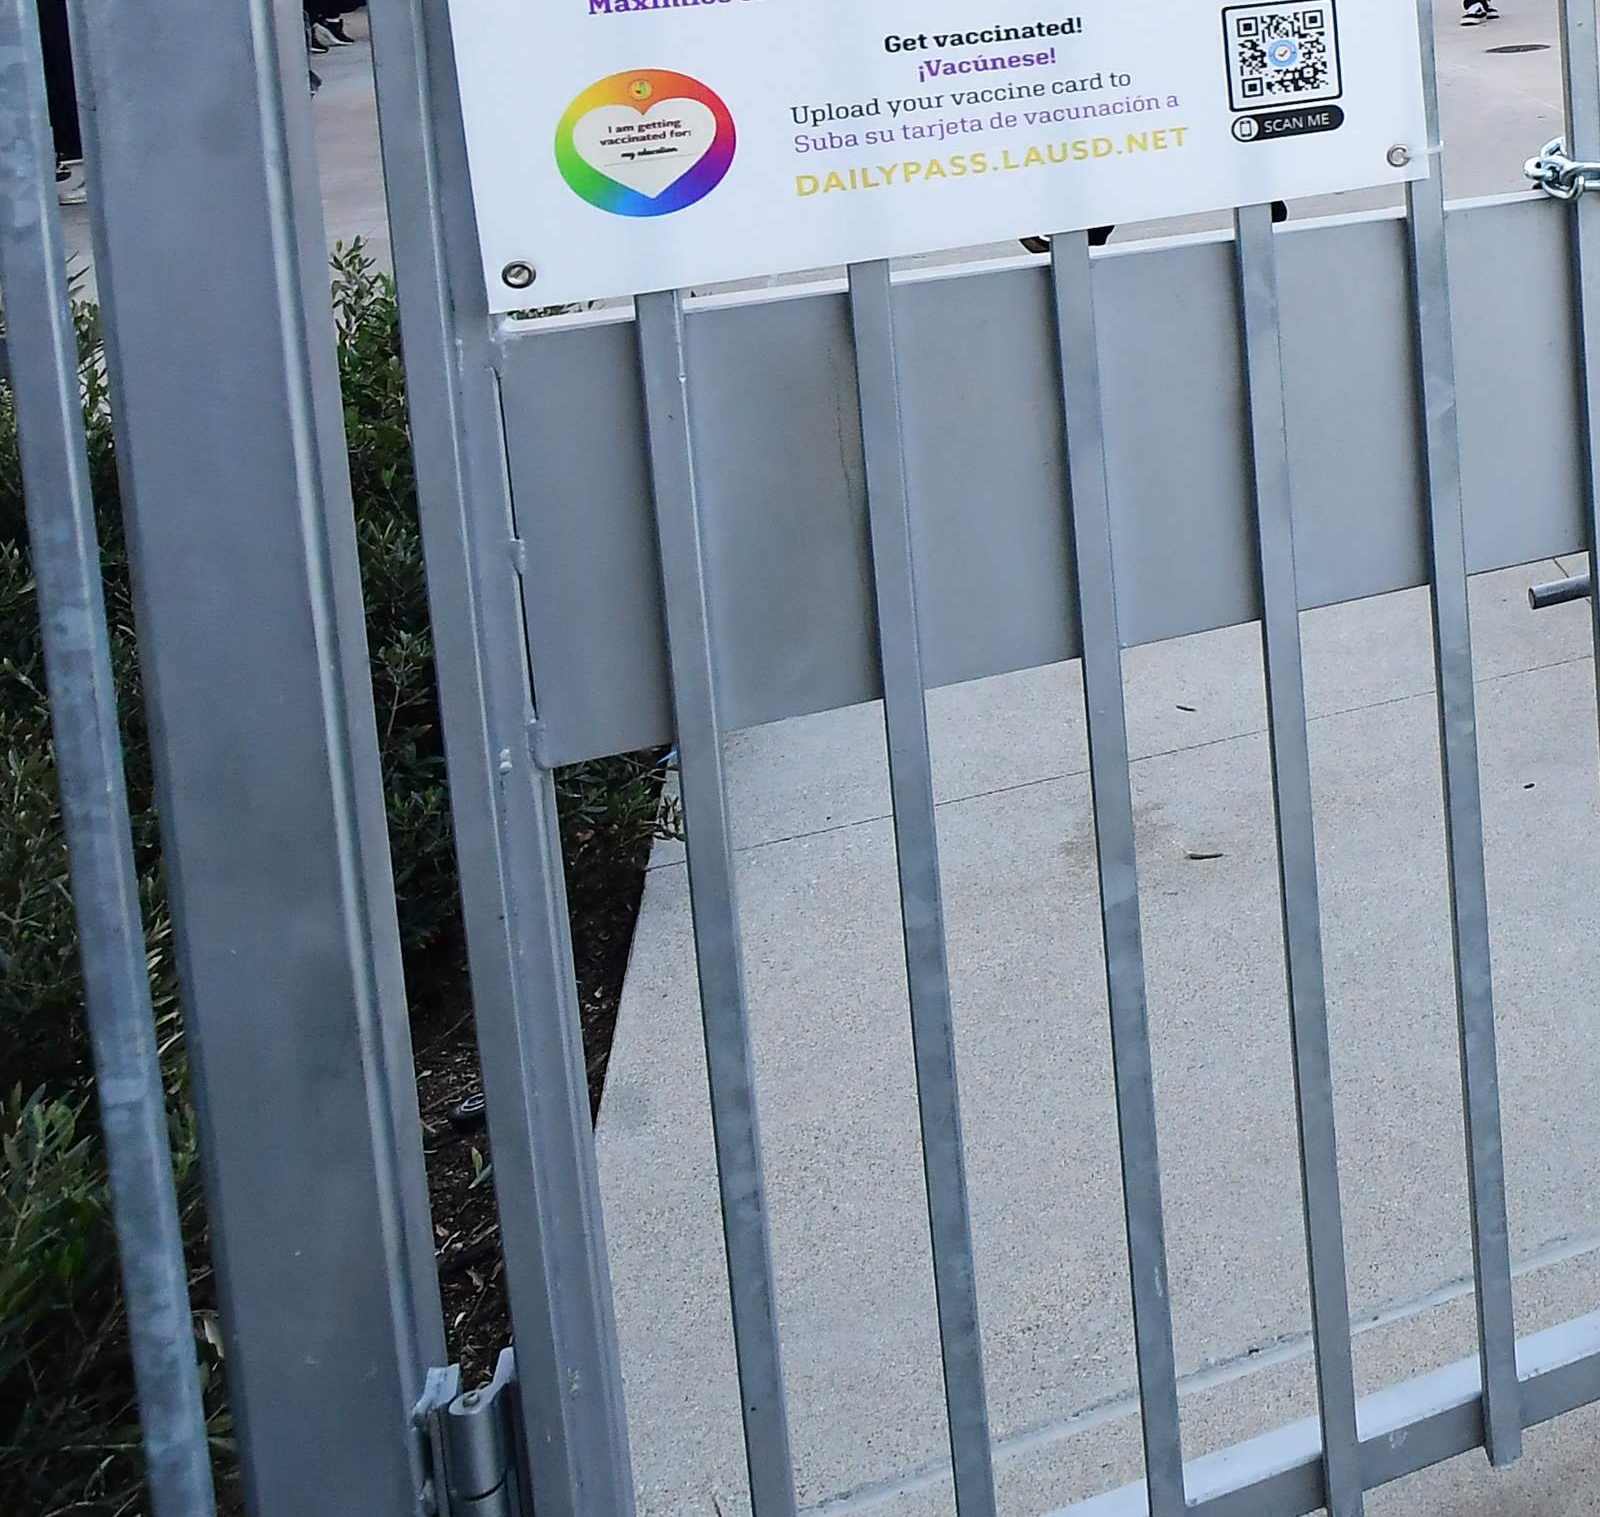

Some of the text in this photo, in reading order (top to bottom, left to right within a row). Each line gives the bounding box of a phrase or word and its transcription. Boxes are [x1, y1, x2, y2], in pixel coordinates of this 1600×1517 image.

[884, 16, 1082, 52] Get vaccinated!
[918, 46, 1055, 82] ¡Vacúnese!
[789, 72, 1130, 127] Upload your vaccine card to
[600, 131, 666, 146] vaccinated
[616, 125, 634, 134] am
[637, 119, 682, 133] getting
[794, 95, 1178, 153] Suba su tarjeta de vacunación a
[1264, 112, 1329, 132] SCAN ME
[795, 126, 1188, 196] DAILYPASS.LAUSD.NET
